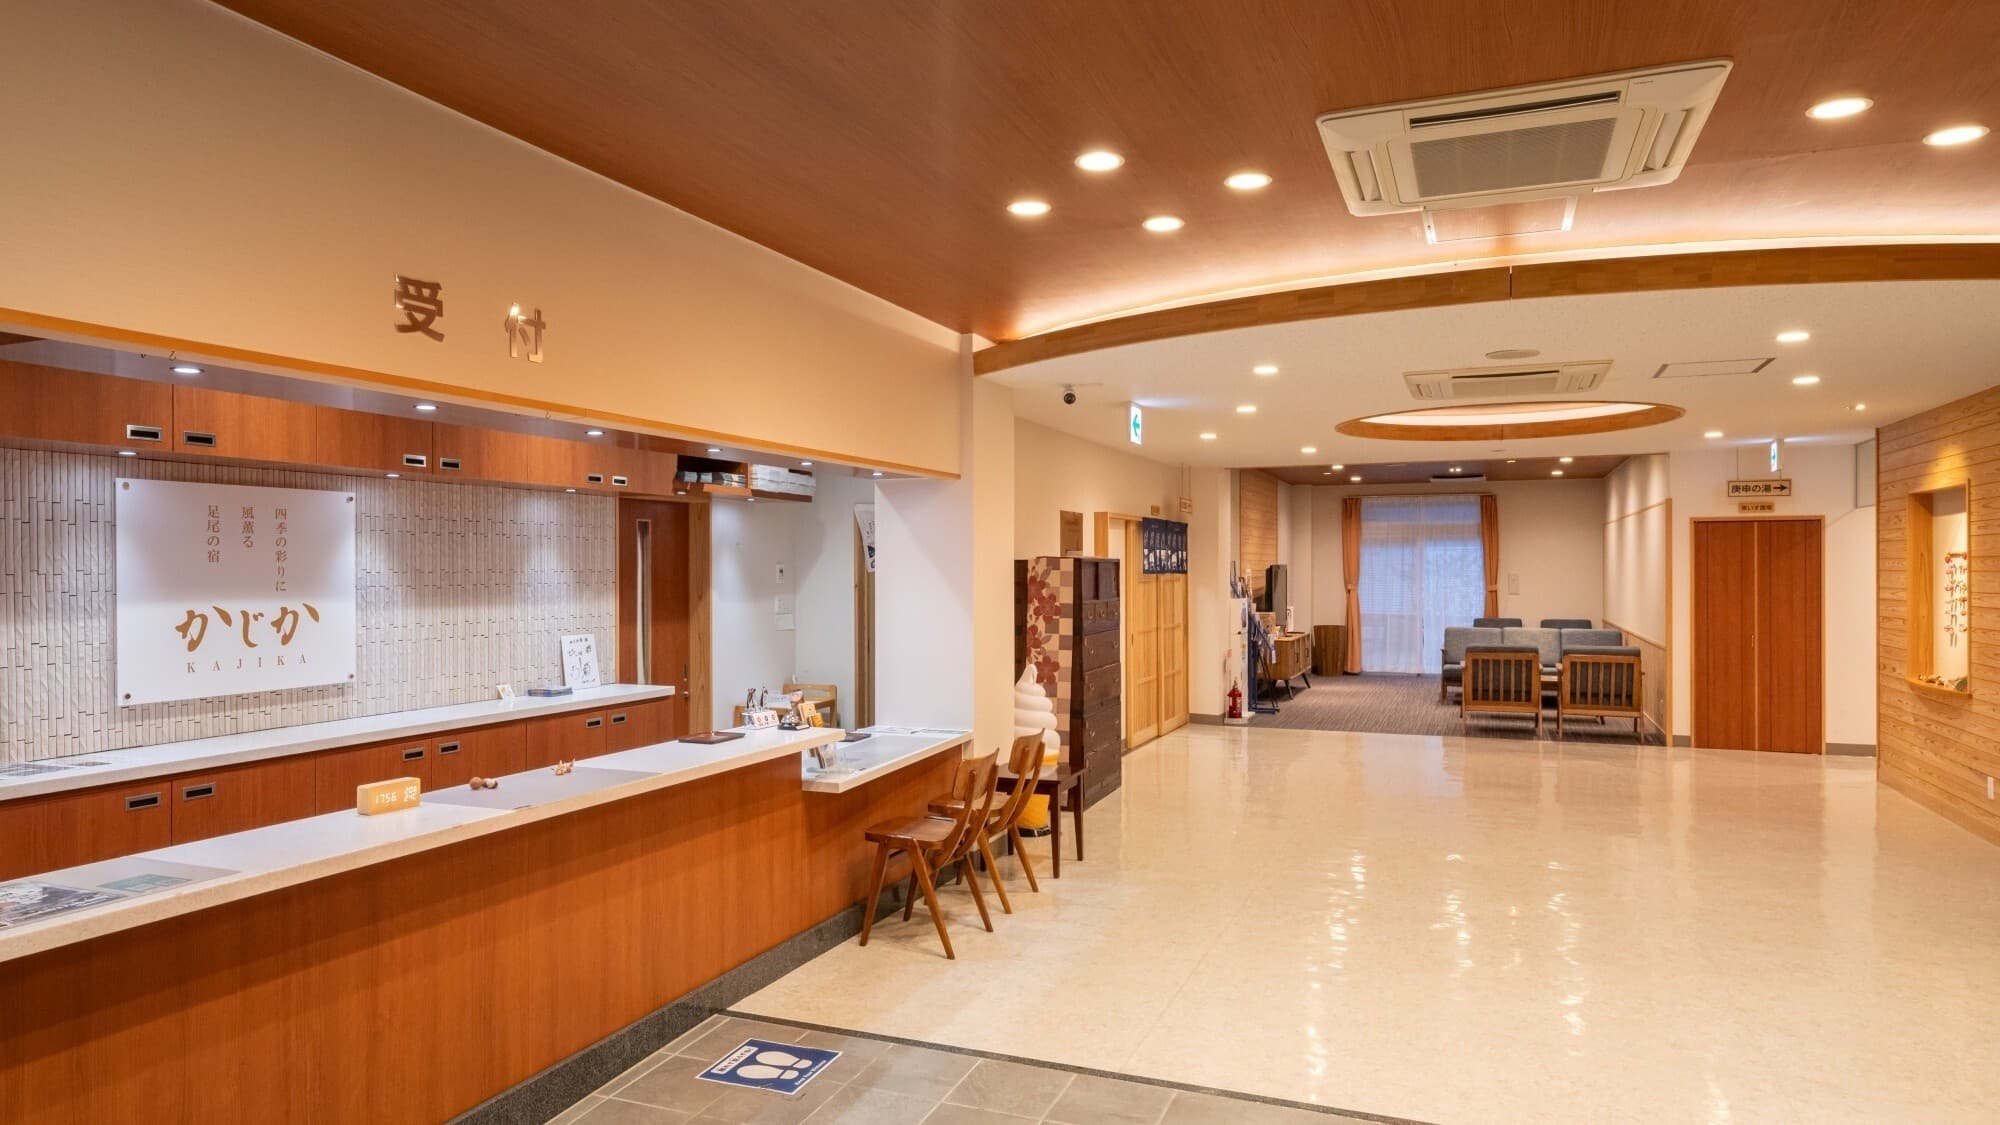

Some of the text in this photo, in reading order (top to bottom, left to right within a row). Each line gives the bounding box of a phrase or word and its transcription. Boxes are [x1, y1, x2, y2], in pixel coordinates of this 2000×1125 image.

[394, 272, 546, 363] 受付
[207, 504, 220, 563] 足尾の宿
[242, 506, 255, 549] 風薫る
[275, 508, 287, 592] 四季の彩りに
[175, 602, 320, 652] かじか
[187, 653, 306, 674] KAJIKA
